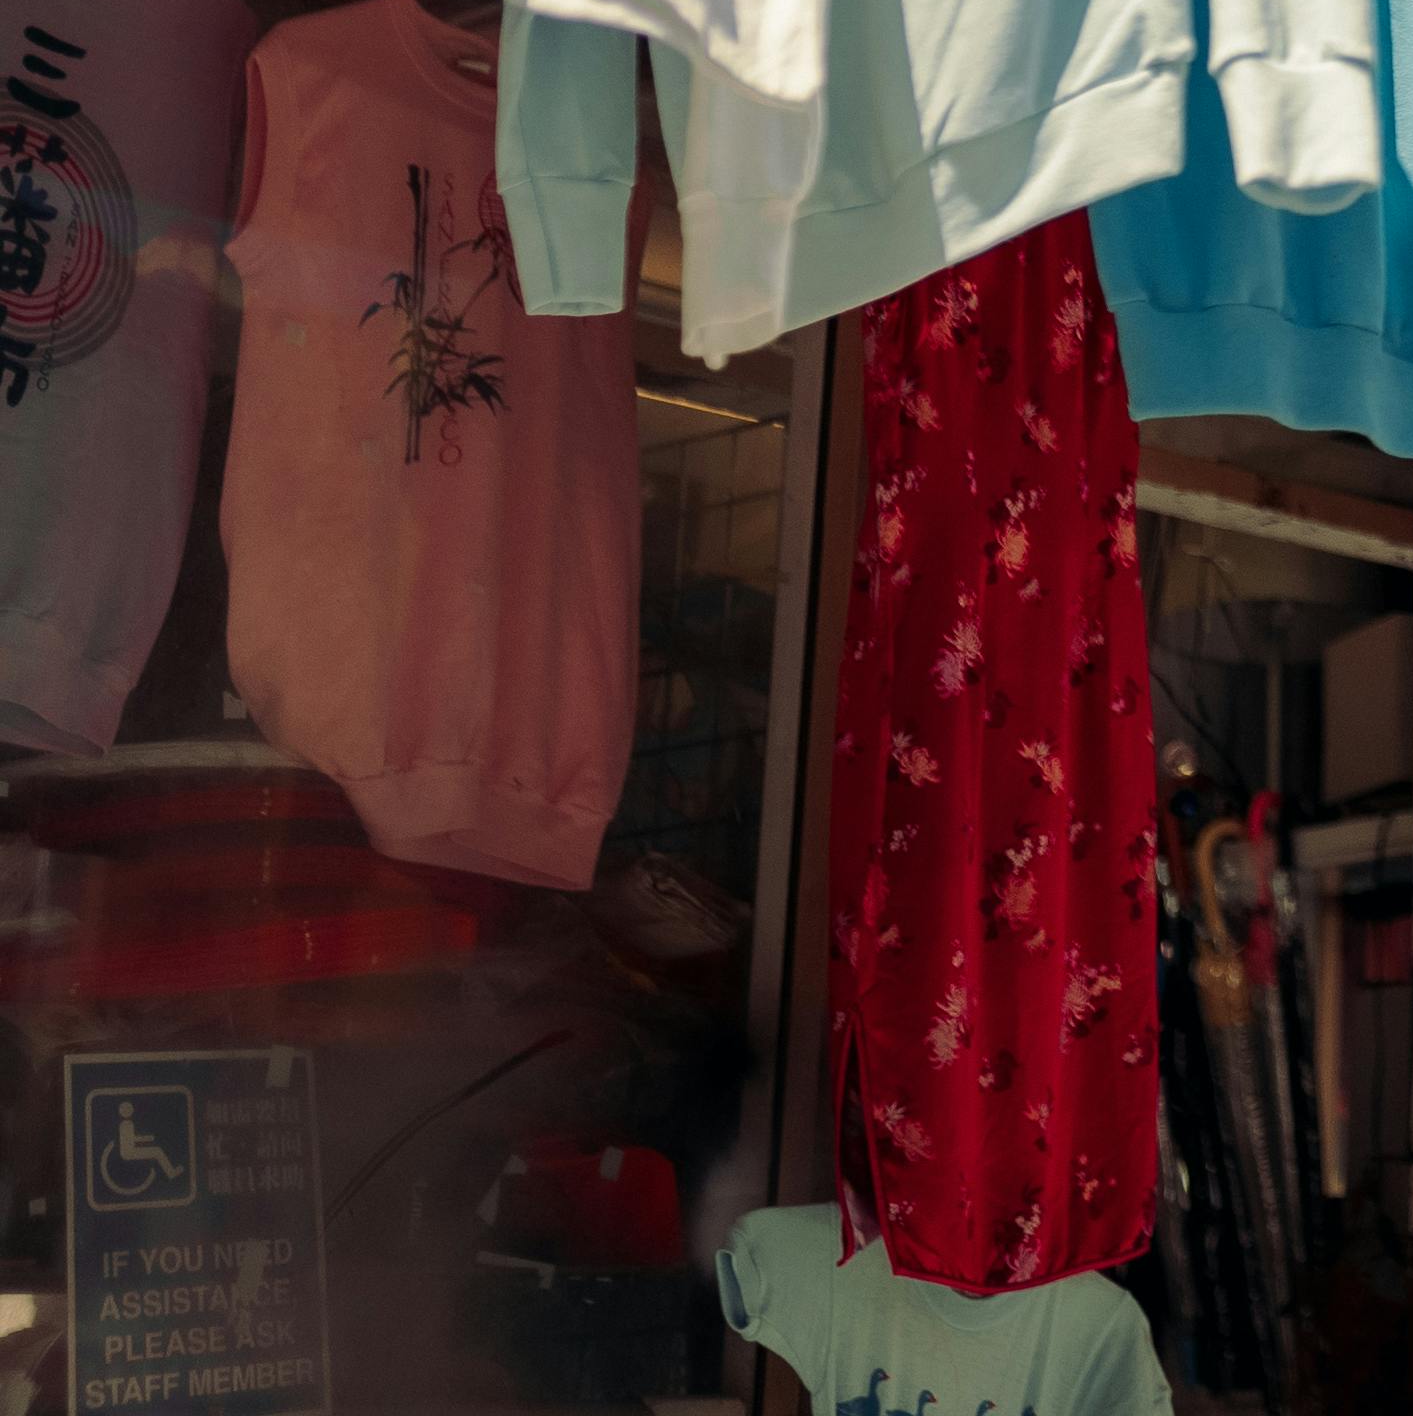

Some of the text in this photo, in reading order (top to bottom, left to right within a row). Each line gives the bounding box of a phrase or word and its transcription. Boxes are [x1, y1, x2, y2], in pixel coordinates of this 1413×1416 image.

[103, 1251, 129, 1278] IF
[140, 1246, 204, 1275] YOU
[104, 1319, 296, 1364] PLEASE ASK
[84, 1359, 314, 1409] STAFF MEMBER
